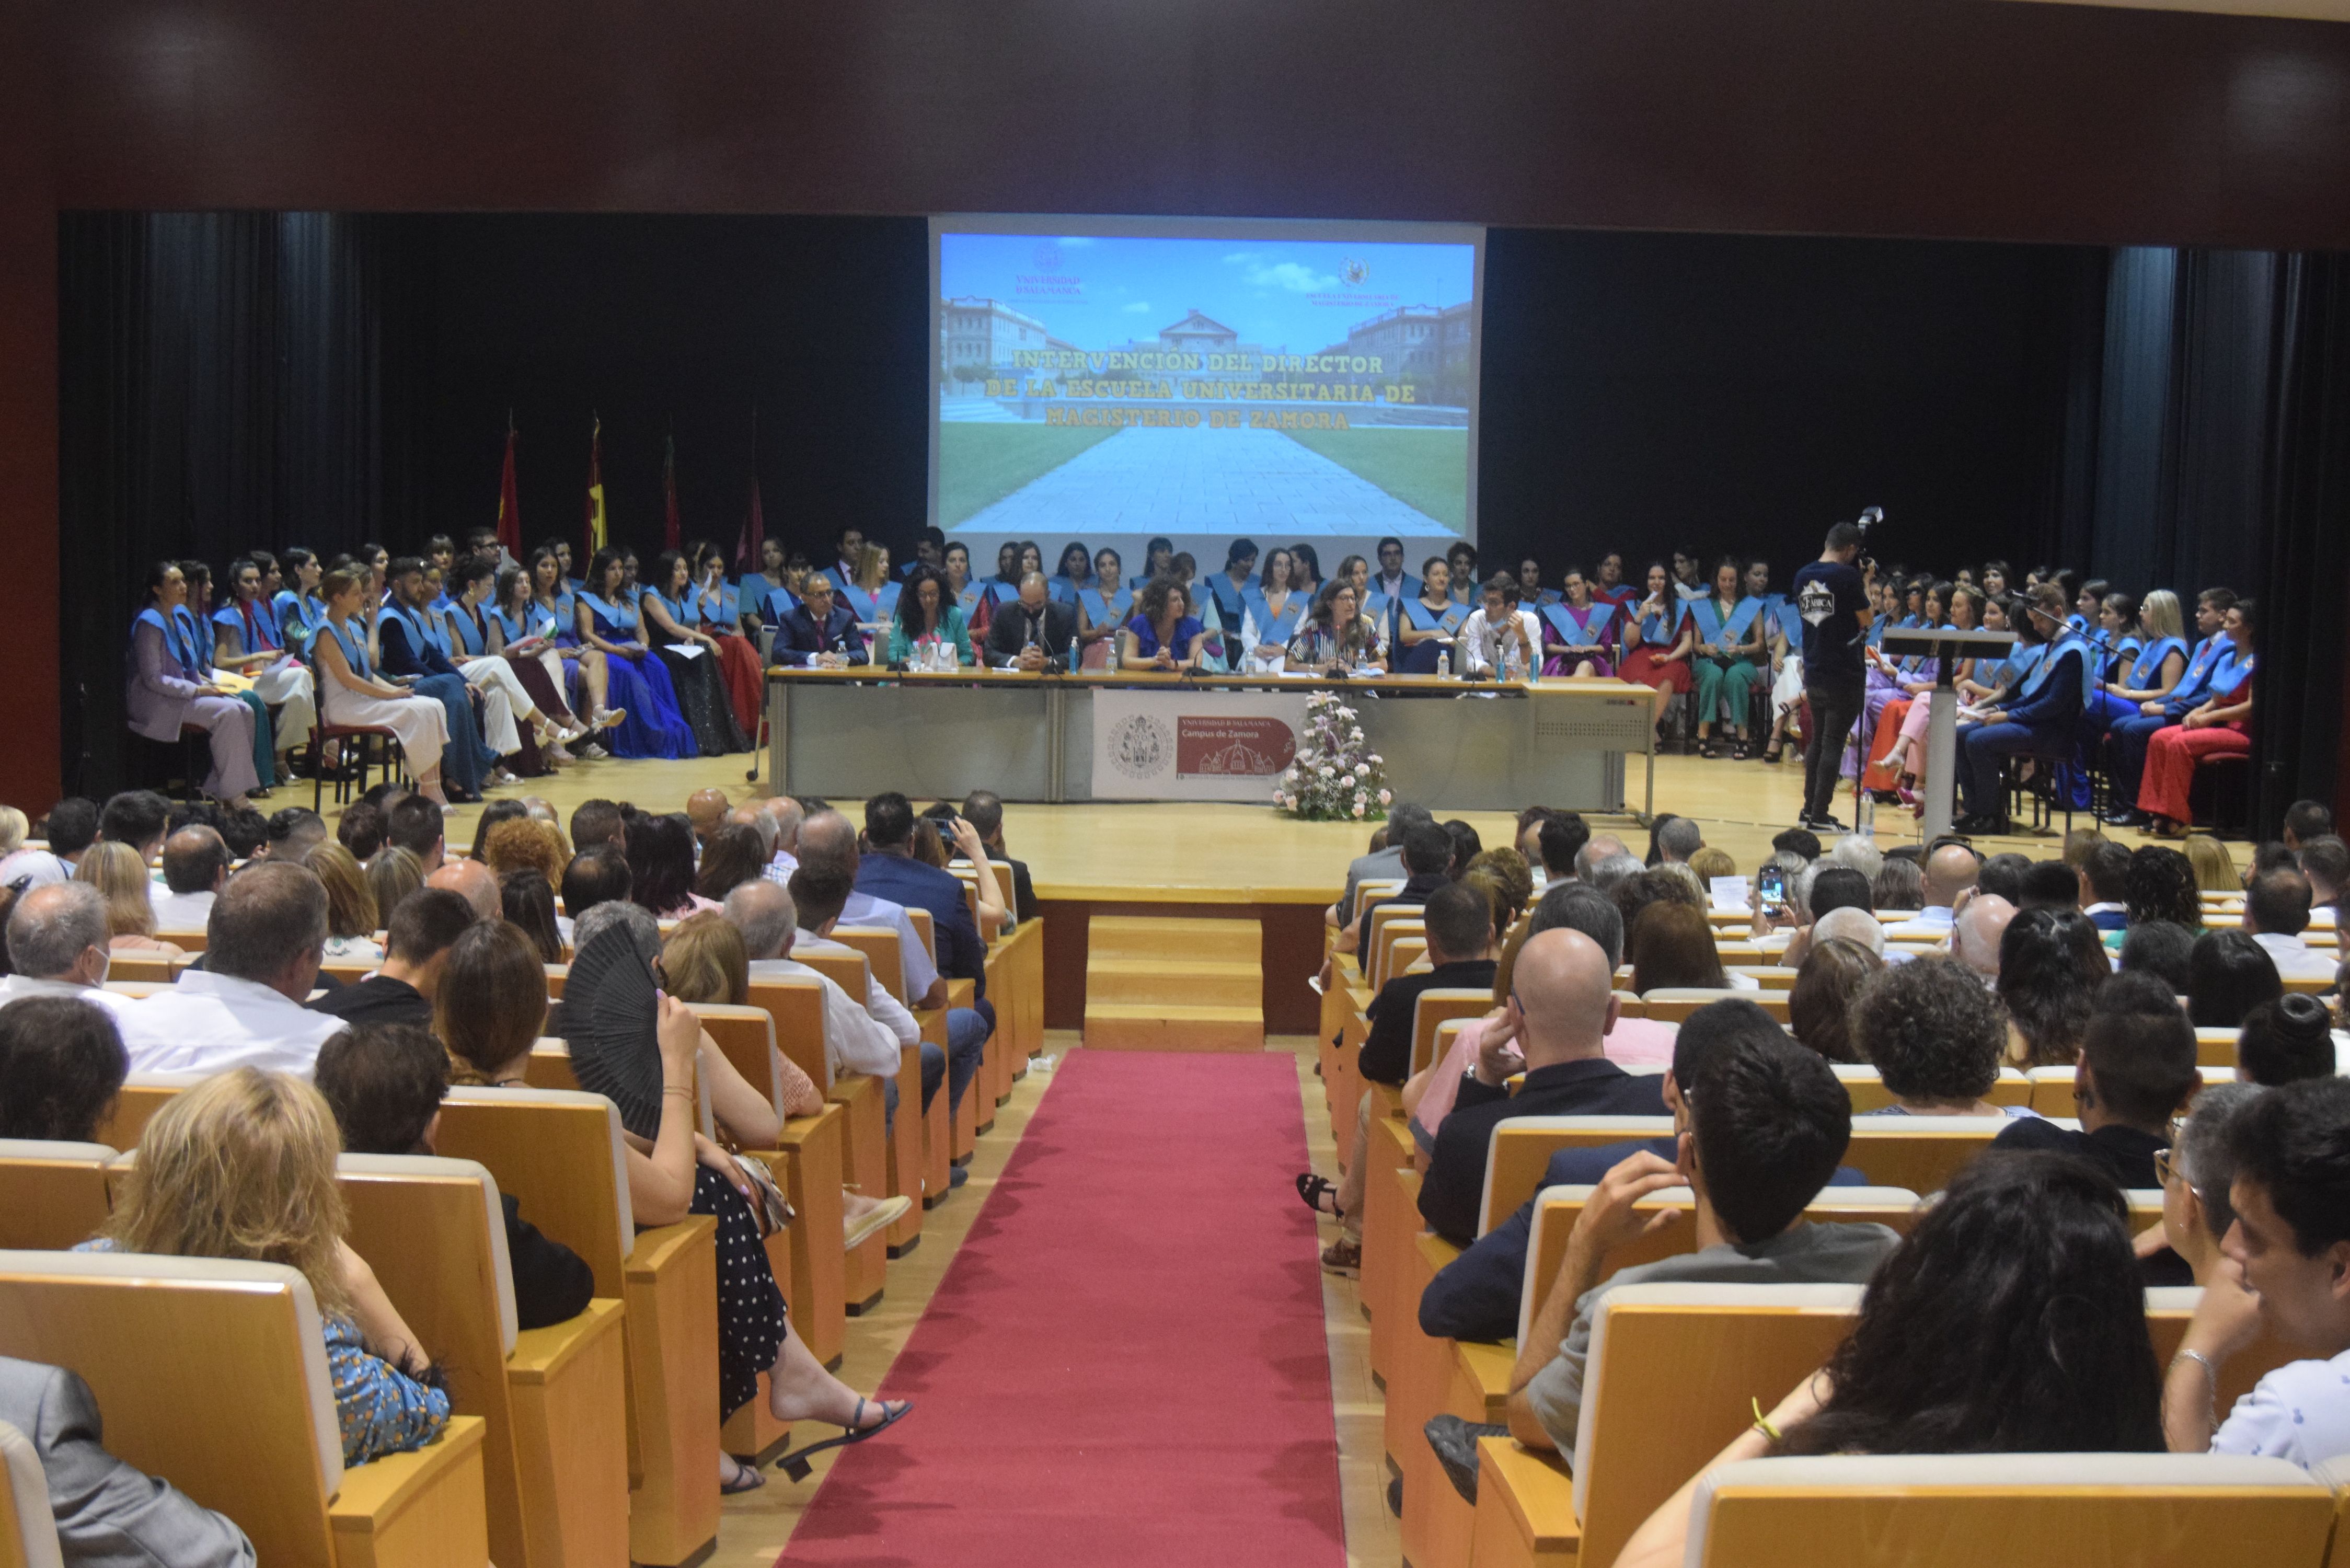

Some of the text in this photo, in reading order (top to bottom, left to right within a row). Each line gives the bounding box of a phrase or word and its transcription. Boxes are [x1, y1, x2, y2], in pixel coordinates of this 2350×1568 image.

[1012, 347, 1383, 374] INTERVENCIÓN DEL DIRECTOR
[985, 379, 1415, 402] DE LA ESCUELA UNIVERSITARIA DE
[1045, 407, 1350, 430] MAGISTERIO DE ZAMORA
[1182, 729, 1259, 740] Campus de Zamora
[1232, 719, 1271, 728] SALAMANCA
